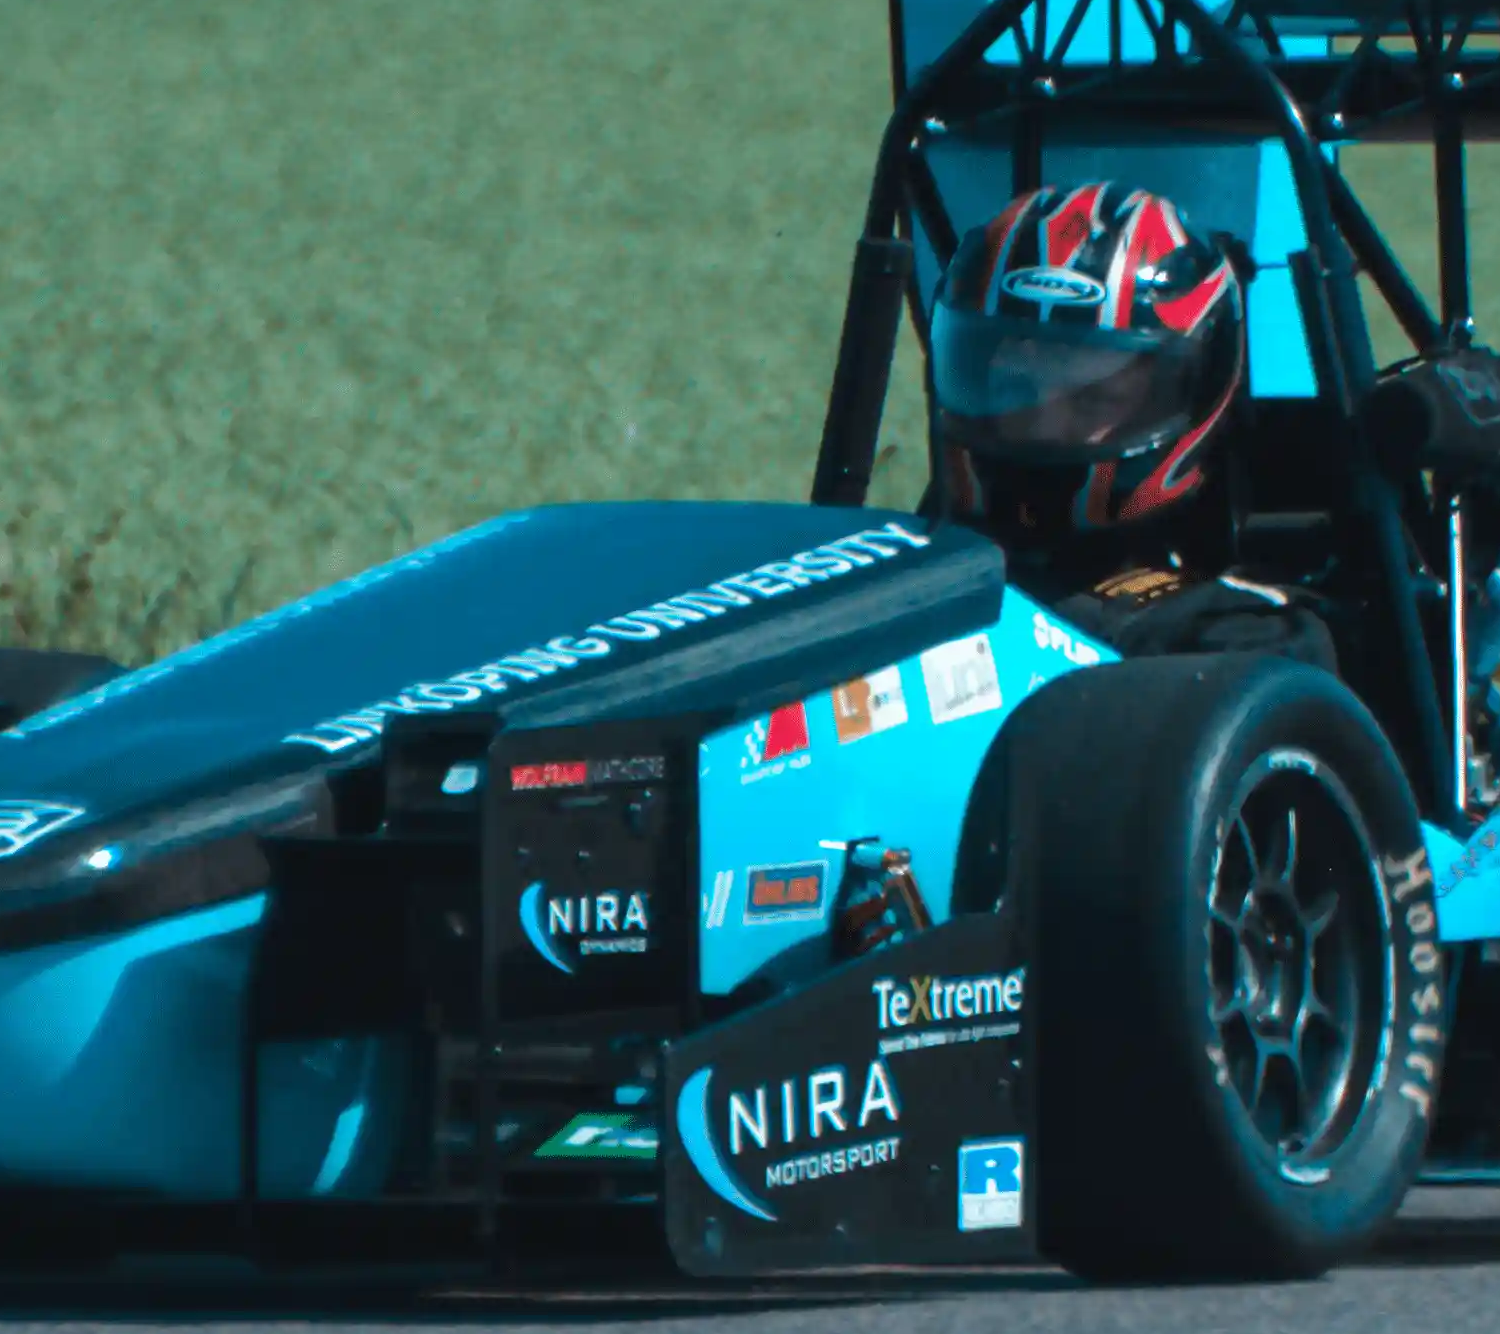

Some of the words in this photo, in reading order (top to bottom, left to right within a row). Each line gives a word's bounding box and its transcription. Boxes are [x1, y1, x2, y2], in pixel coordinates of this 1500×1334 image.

[591, 521, 930, 643] UNIVERSITY
[548, 893, 649, 936] NIRA
[871, 973, 1024, 1030] TeXtreme
[727, 1061, 901, 1156] NIRA
[766, 1138, 901, 1188] MOTORSPORT
